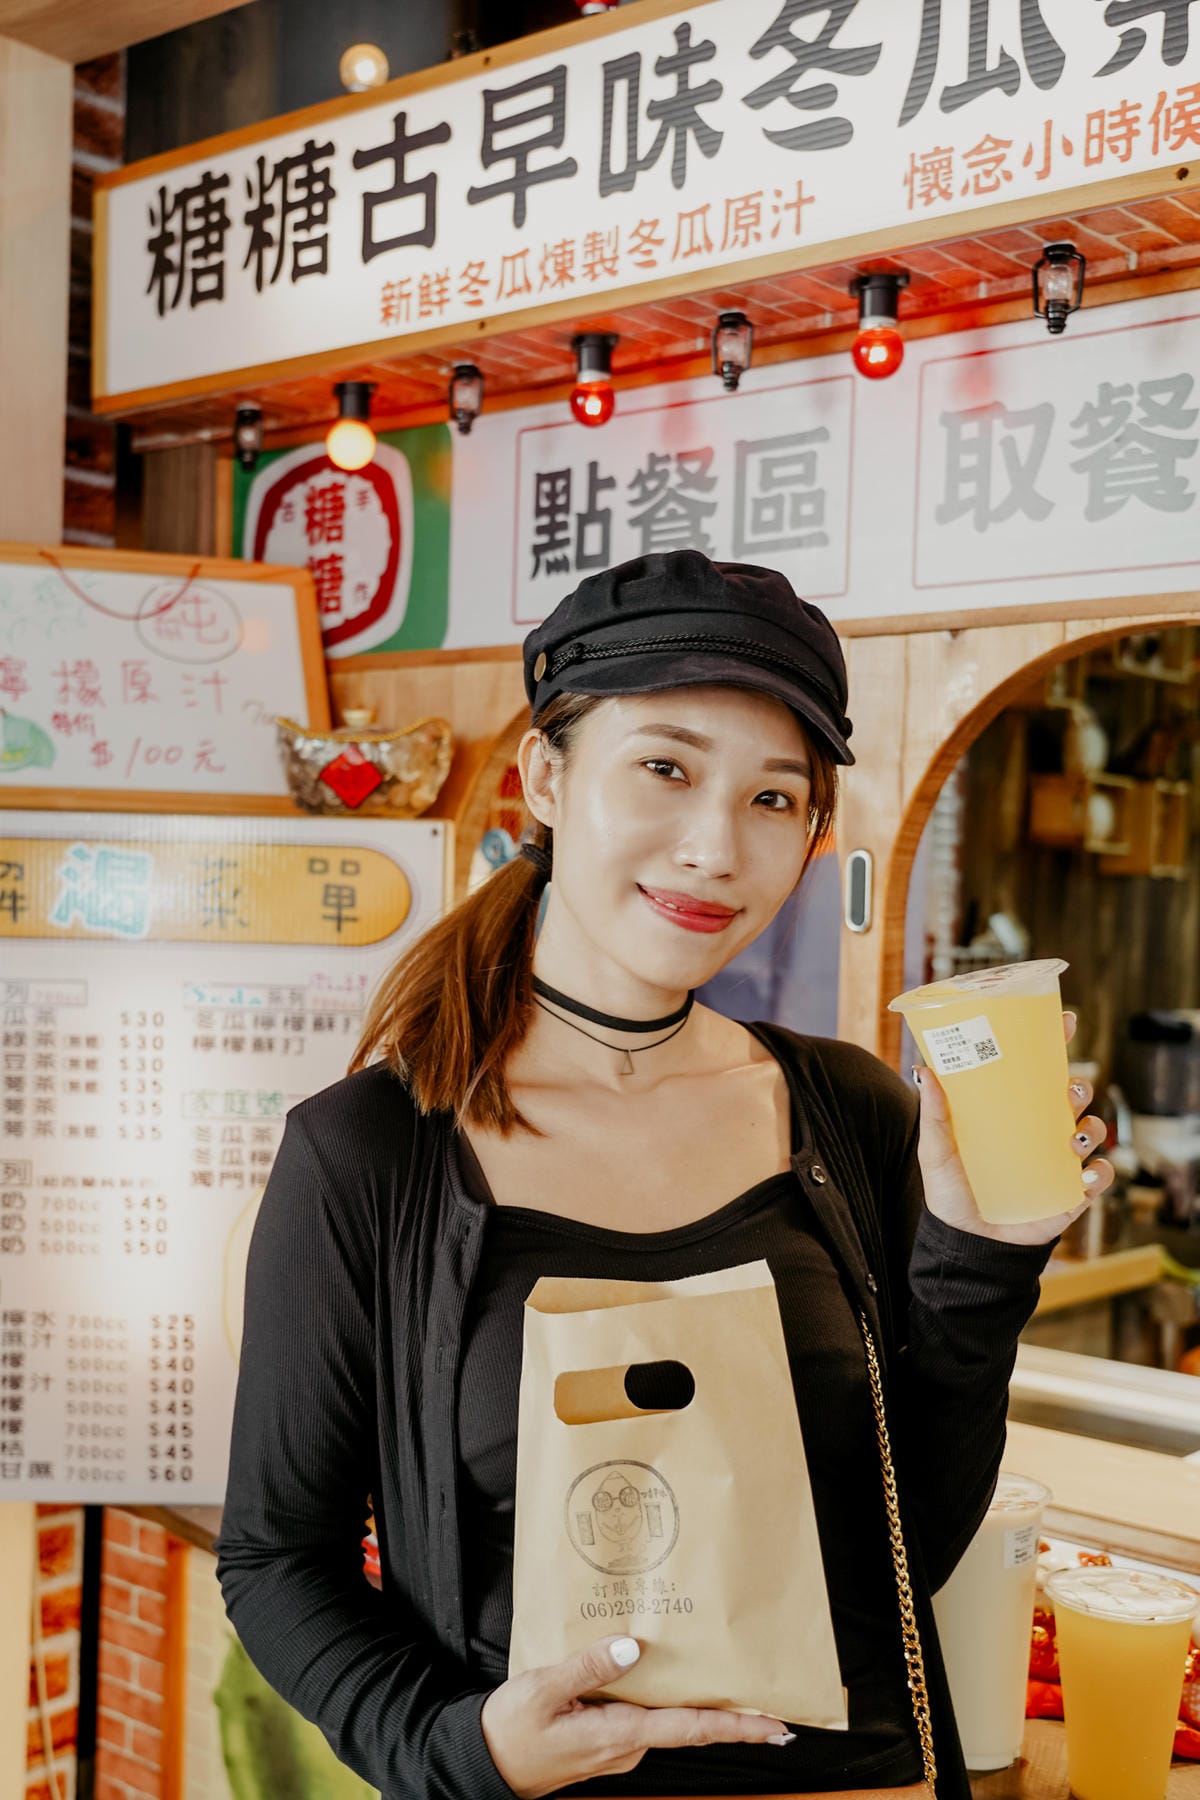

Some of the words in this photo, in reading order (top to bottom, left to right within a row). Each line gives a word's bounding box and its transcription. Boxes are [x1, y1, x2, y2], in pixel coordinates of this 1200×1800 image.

[530, 425, 831, 580] 點餐區
[580, 1597, 693, 1620] (06)298-2740
